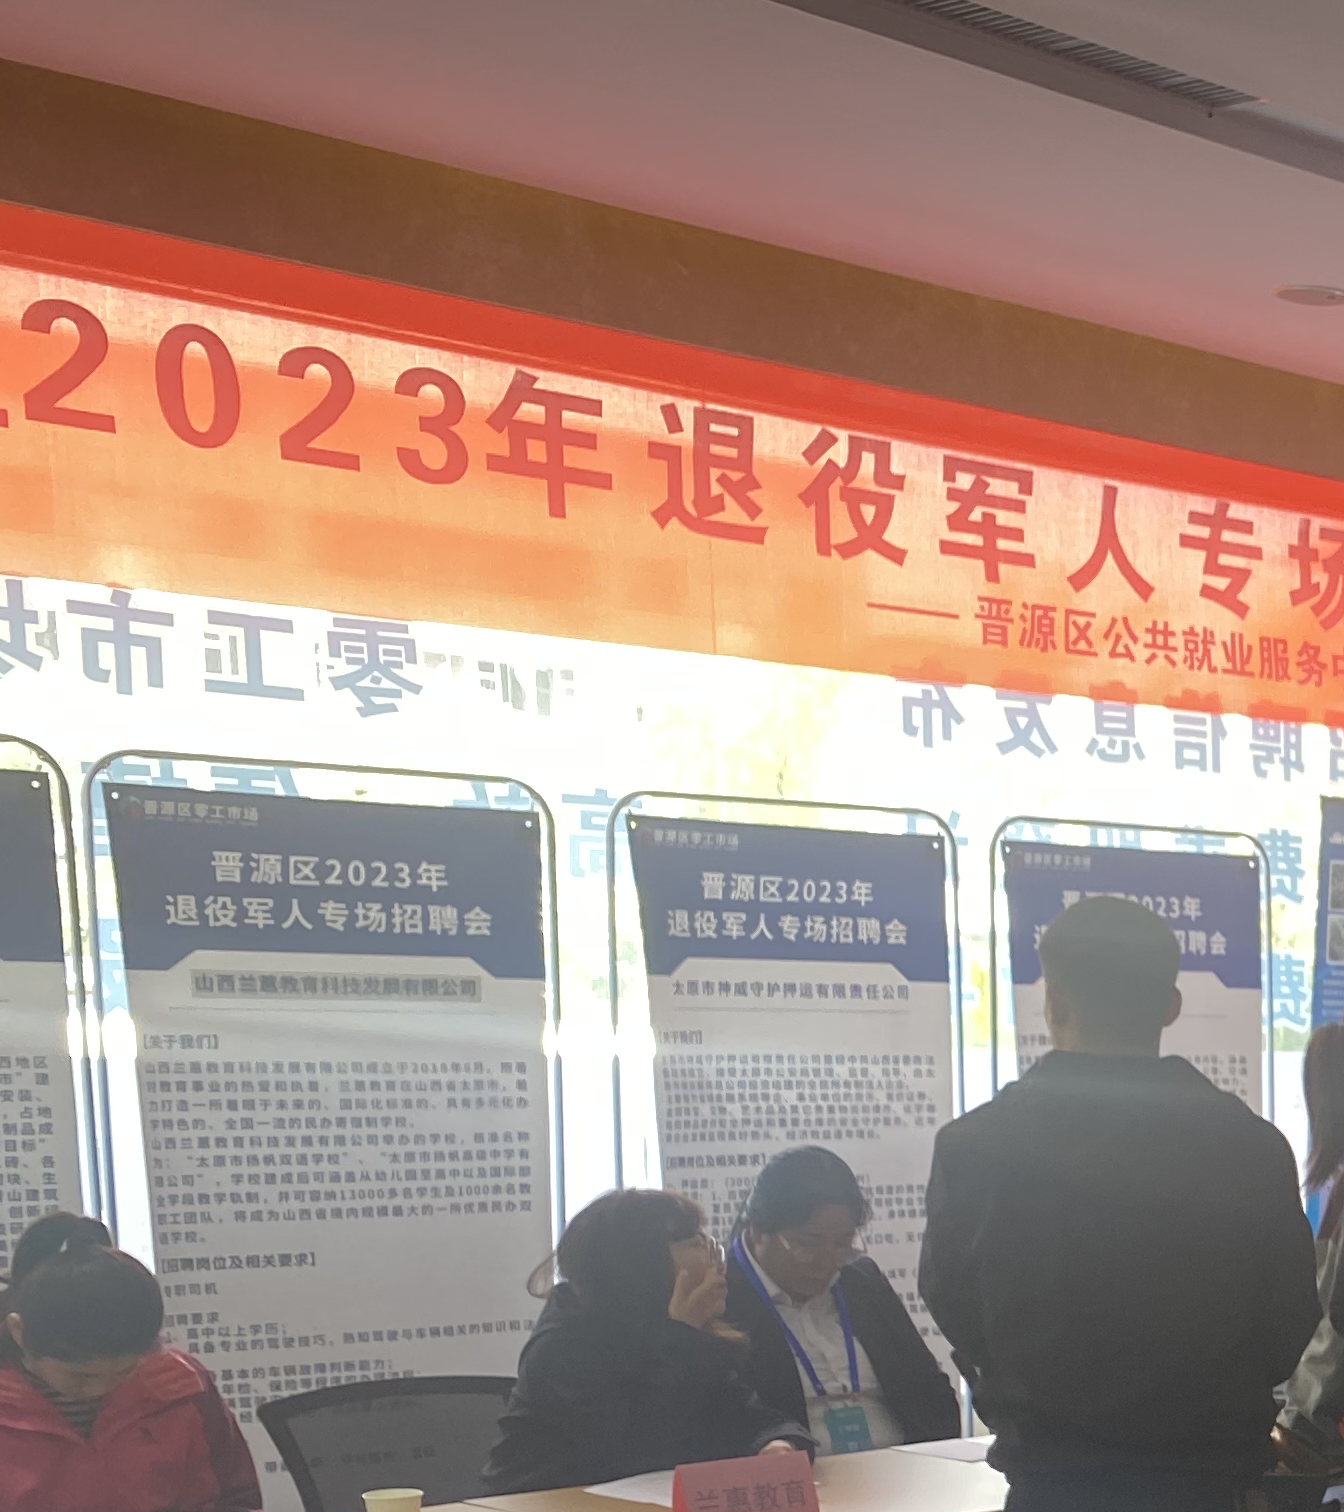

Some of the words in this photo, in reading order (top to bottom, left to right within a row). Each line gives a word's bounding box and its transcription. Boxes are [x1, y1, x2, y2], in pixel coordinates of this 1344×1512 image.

[211, 850, 449, 892] 晋源区2023年
[700, 870, 874, 907] 晋源区2023年
[165, 894, 493, 938] 退役军人专场招聘会
[667, 908, 908, 946] 退役军人专场招聘会
